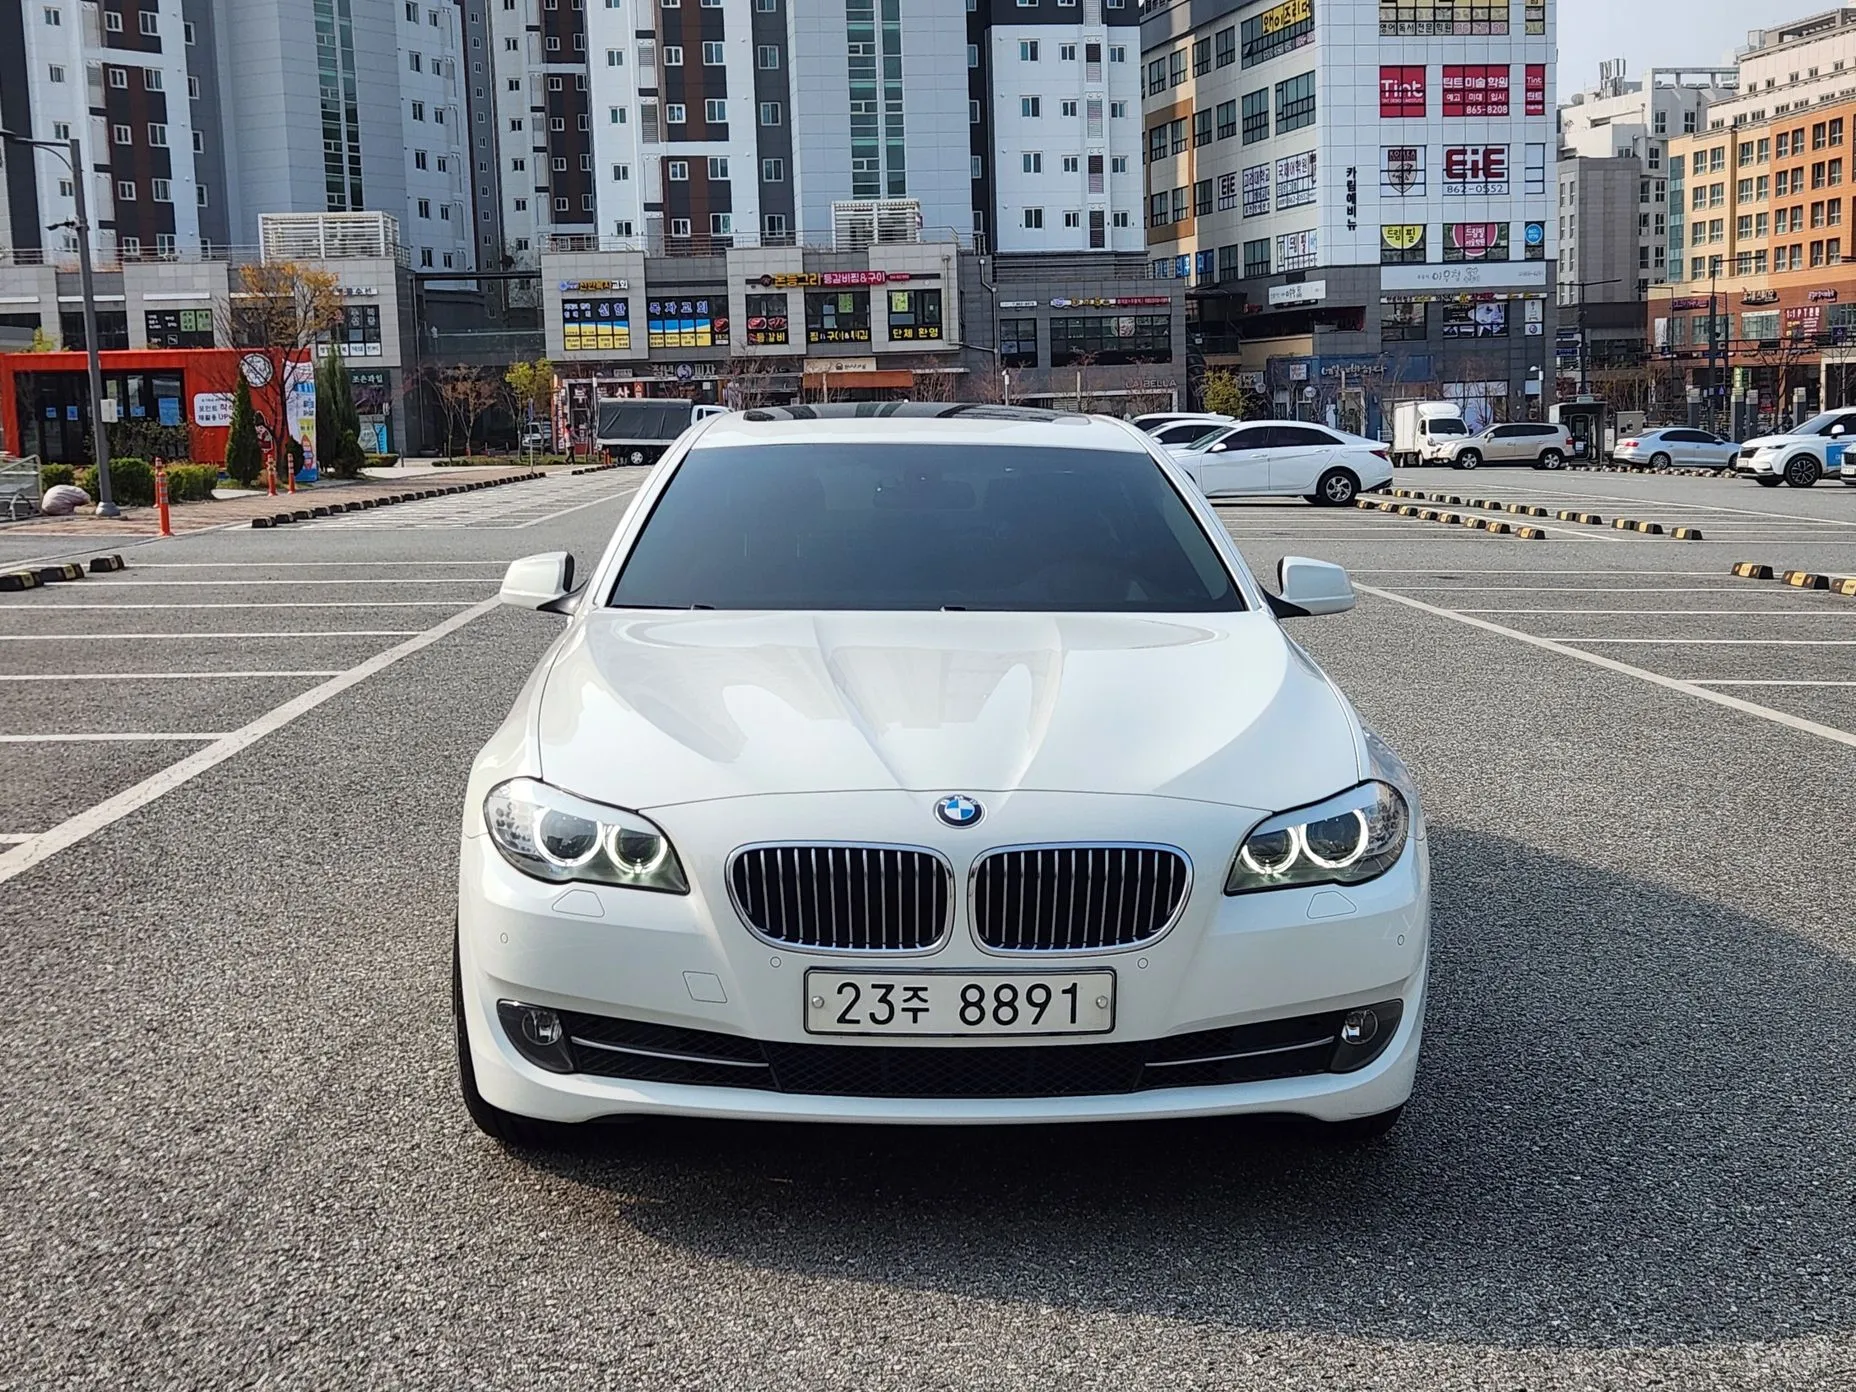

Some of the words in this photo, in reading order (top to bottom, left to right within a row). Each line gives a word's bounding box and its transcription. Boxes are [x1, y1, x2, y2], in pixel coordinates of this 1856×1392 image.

[1443, 77, 1464, 88] 틴트
[1465, 77, 1486, 88] 미술
[1487, 76, 1509, 88] 학원
[1526, 76, 1543, 84] Tint
[1381, 79, 1424, 98] Tint
[1446, 92, 1461, 101] 예고
[1468, 92, 1483, 101] 미대
[1491, 92, 1505, 101] 입시
[1466, 105, 1508, 115] 865-8208
[1446, 149, 1505, 179] EiE
[1446, 184, 1503, 194] 862-0552
[1465, 227, 1486, 239] 드림필
[823, 271, 886, 284] 등갈비찜&구이
[892, 327, 913, 339] 단체
[918, 327, 938, 338] 환영
[653, 364, 674, 378] 청년
[694, 363, 716, 376] 피자
[836, 982, 930, 1025] 23주
[959, 982, 1079, 1026] 8891
